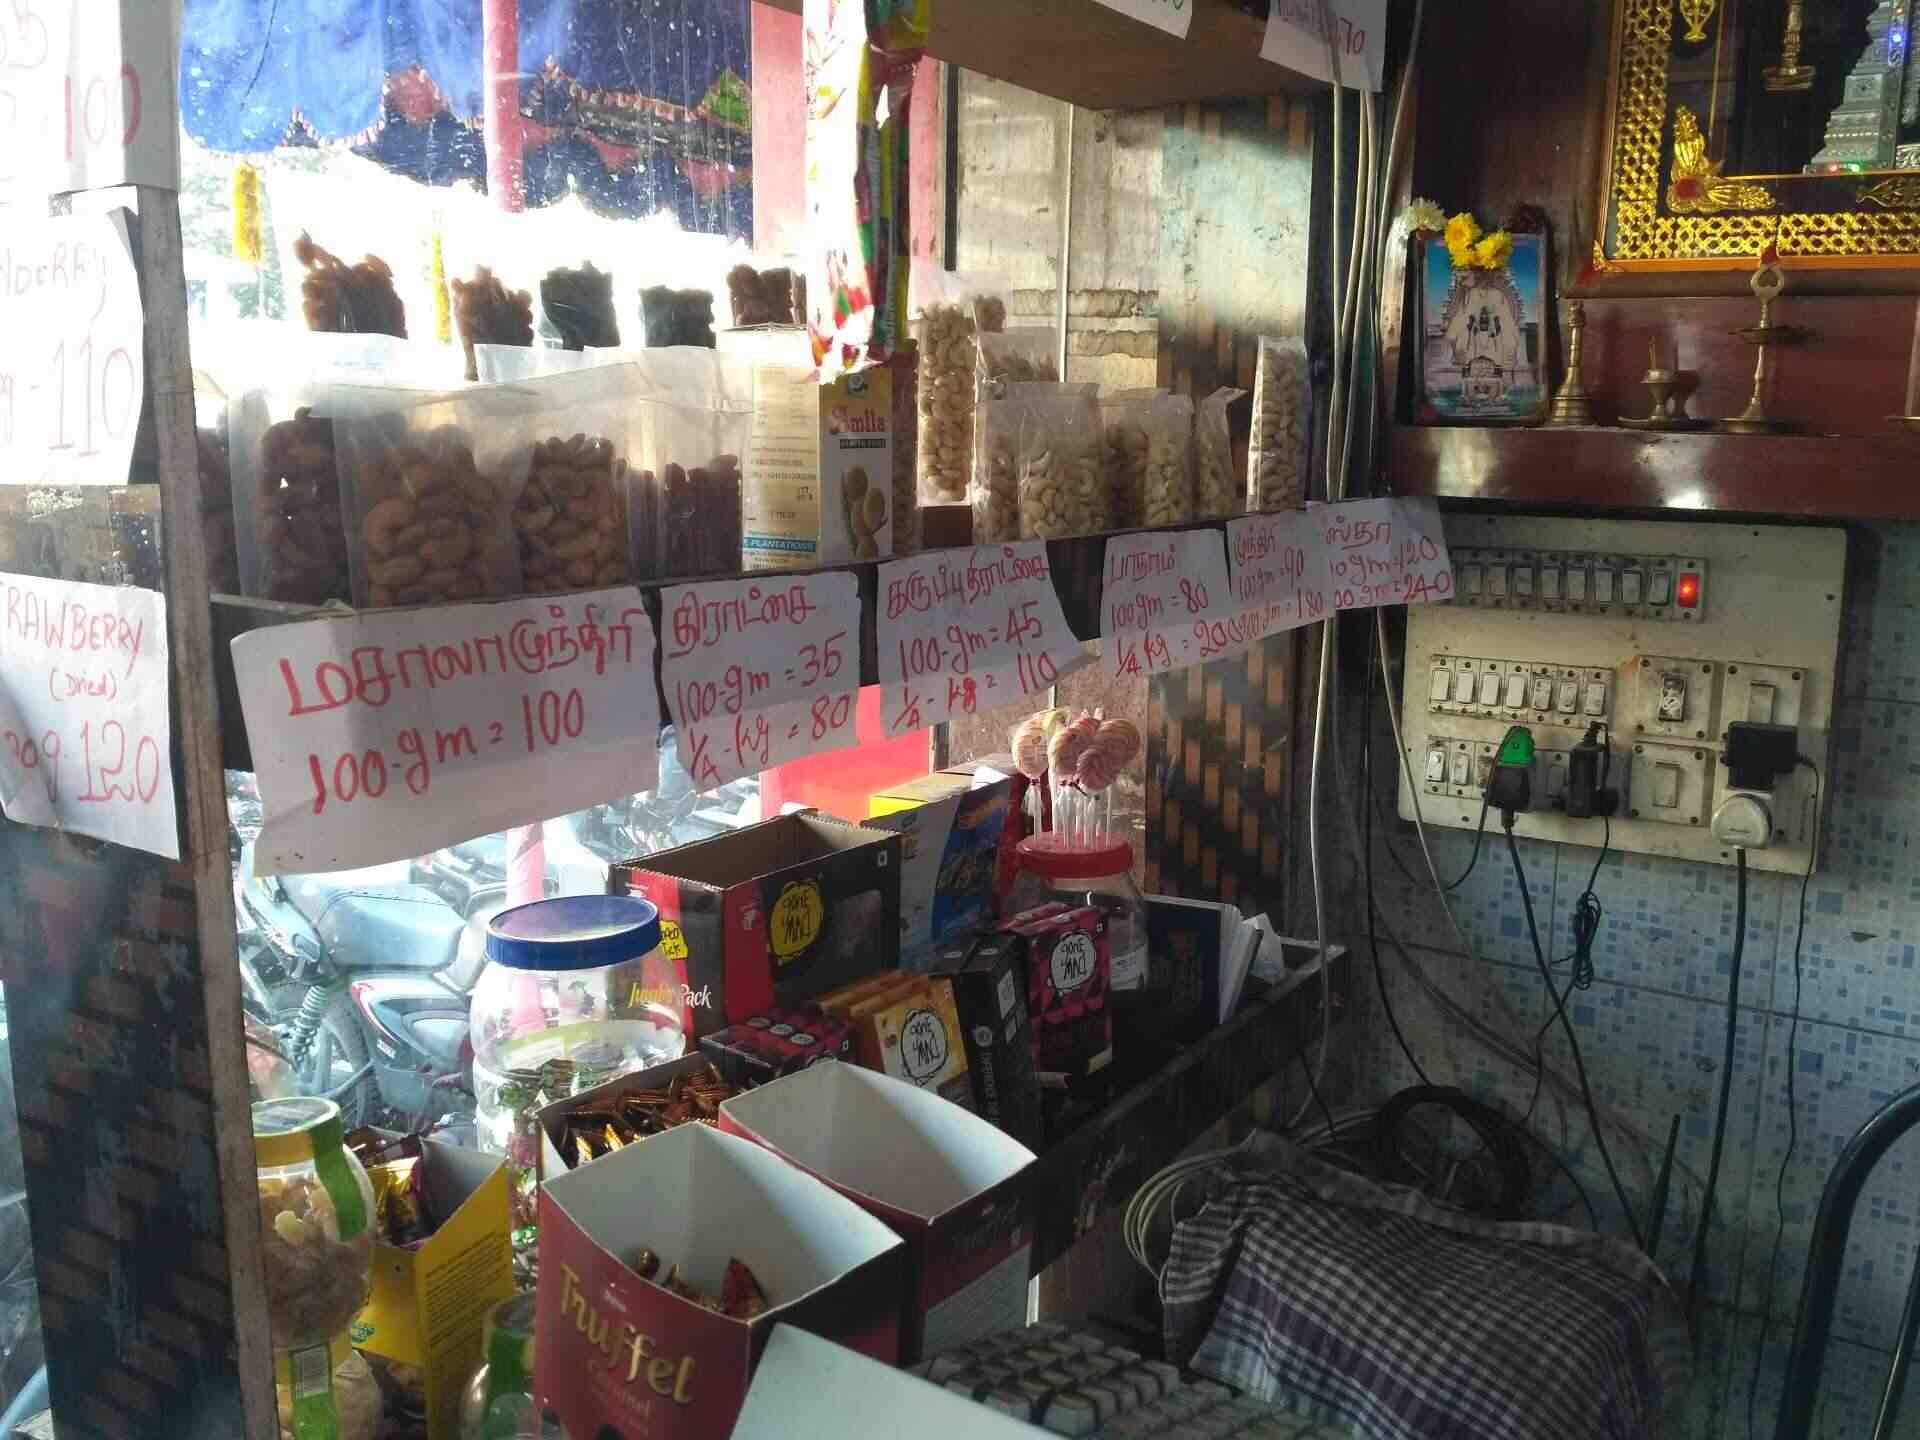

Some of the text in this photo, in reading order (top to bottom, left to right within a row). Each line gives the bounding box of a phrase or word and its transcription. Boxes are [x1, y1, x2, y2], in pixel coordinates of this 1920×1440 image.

[48, 333, 136, 458] 110
[1179, 577, 1209, 614] 80
[0, 579, 143, 678] RAWBERRY
[1005, 600, 1042, 645] 45
[798, 630, 847, 688] 35
[1016, 651, 1057, 694] 110
[521, 687, 586, 752] 100
[811, 694, 850, 741] 80
[77, 719, 161, 804] 120
[680, 983, 713, 1009] Pack
